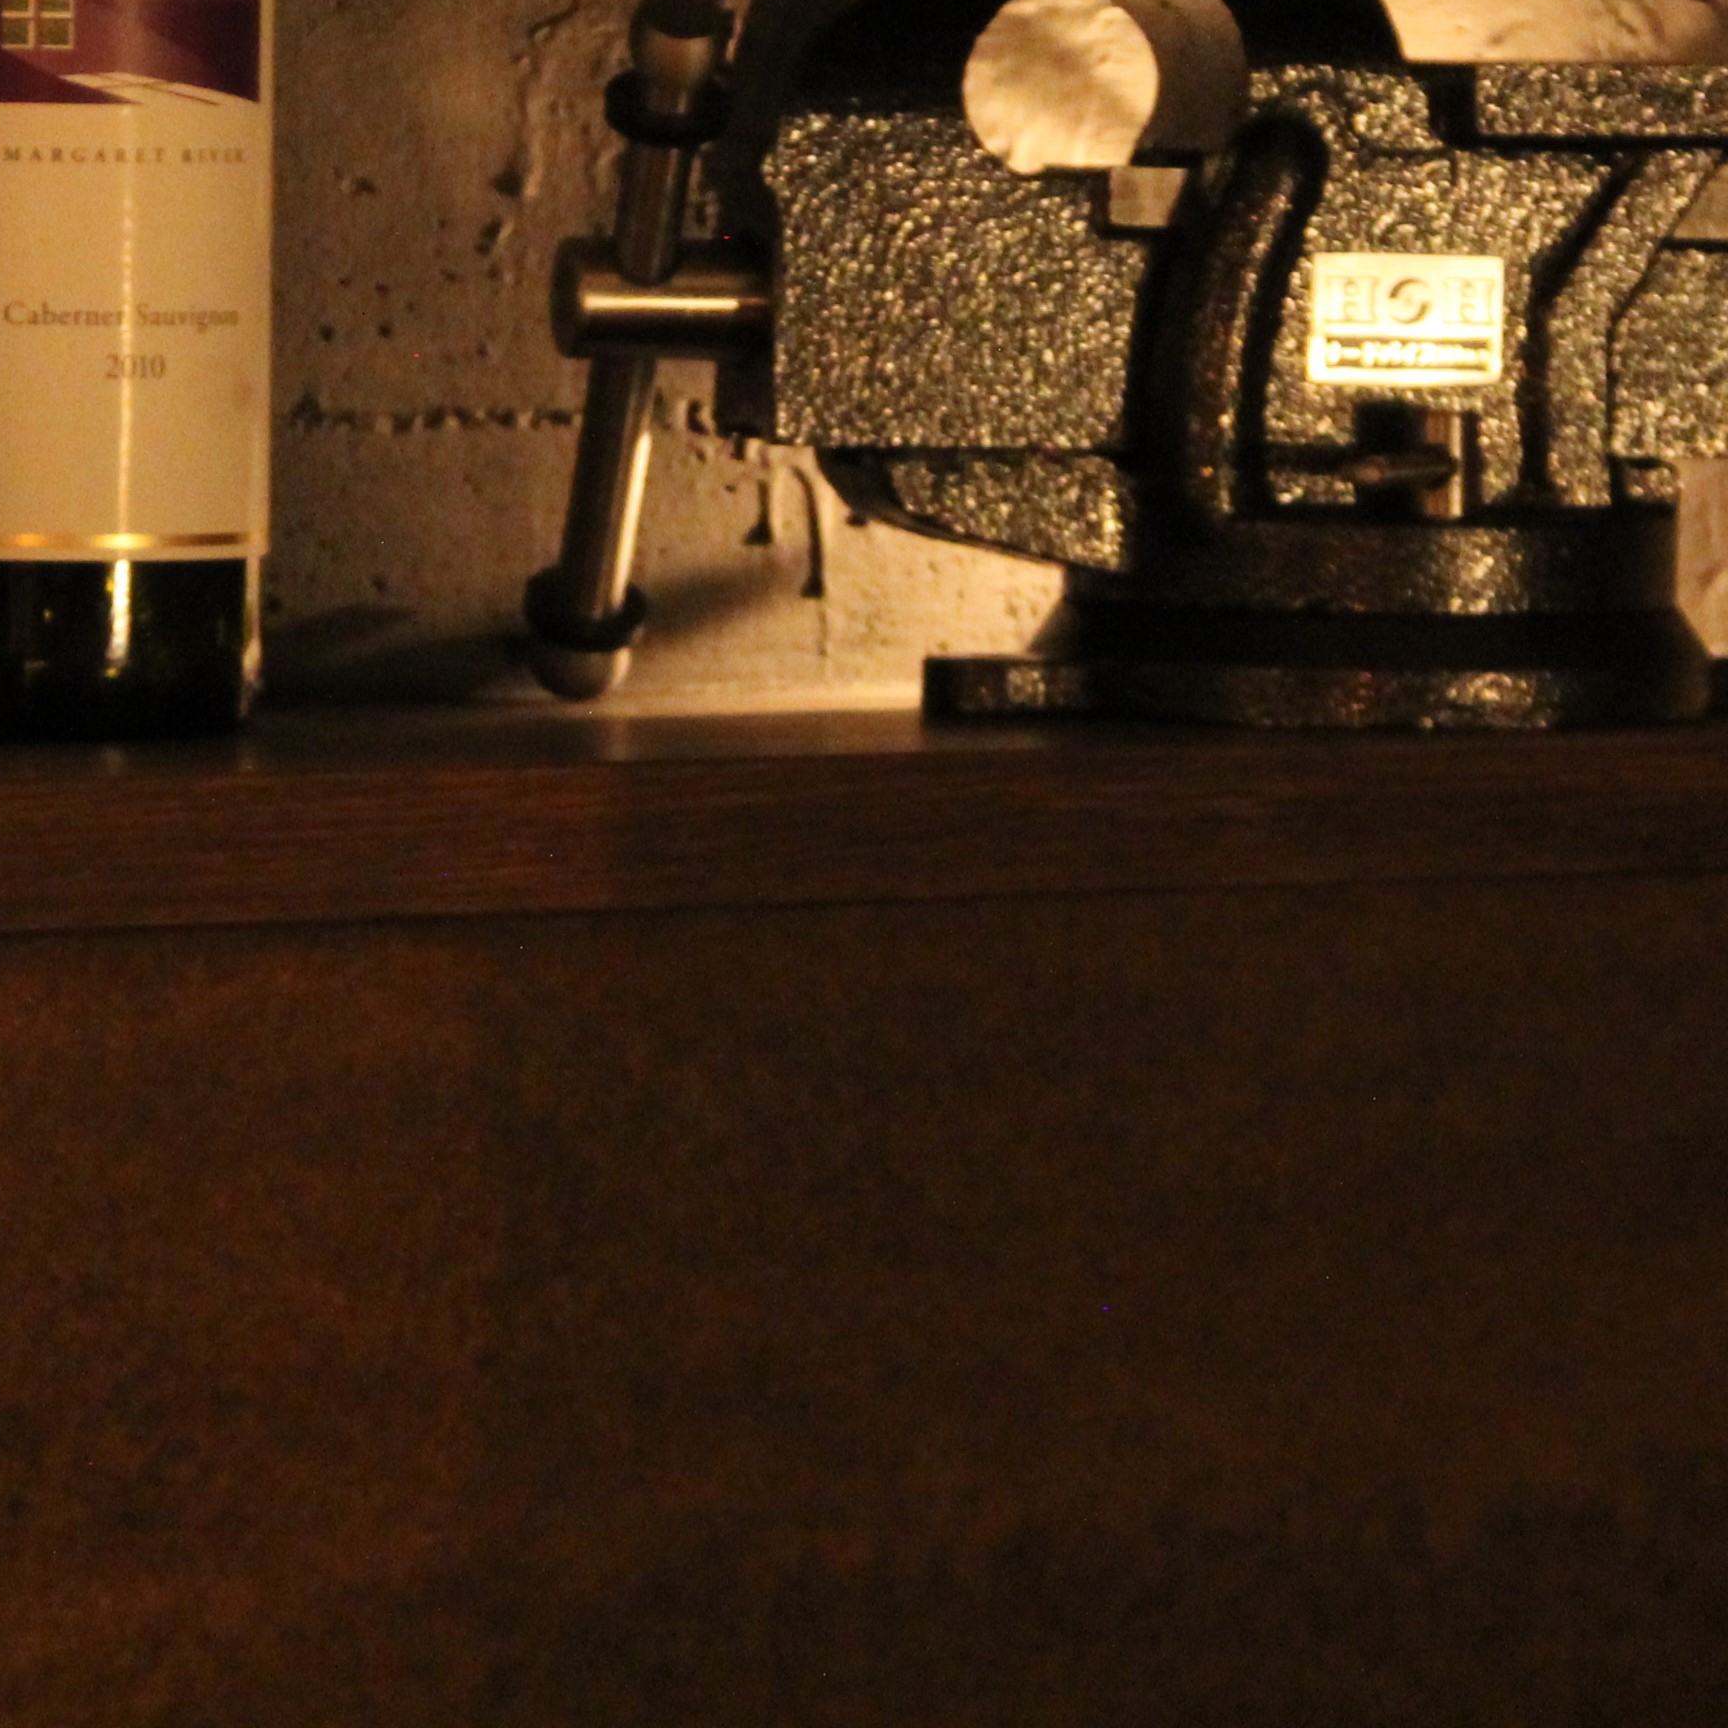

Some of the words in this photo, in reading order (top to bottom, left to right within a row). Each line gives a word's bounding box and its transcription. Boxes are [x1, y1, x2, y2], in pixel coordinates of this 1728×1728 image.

[1, 146, 167, 164] MARGARET
[181, 146, 247, 164] RIVER
[104, 353, 168, 380] 2010
